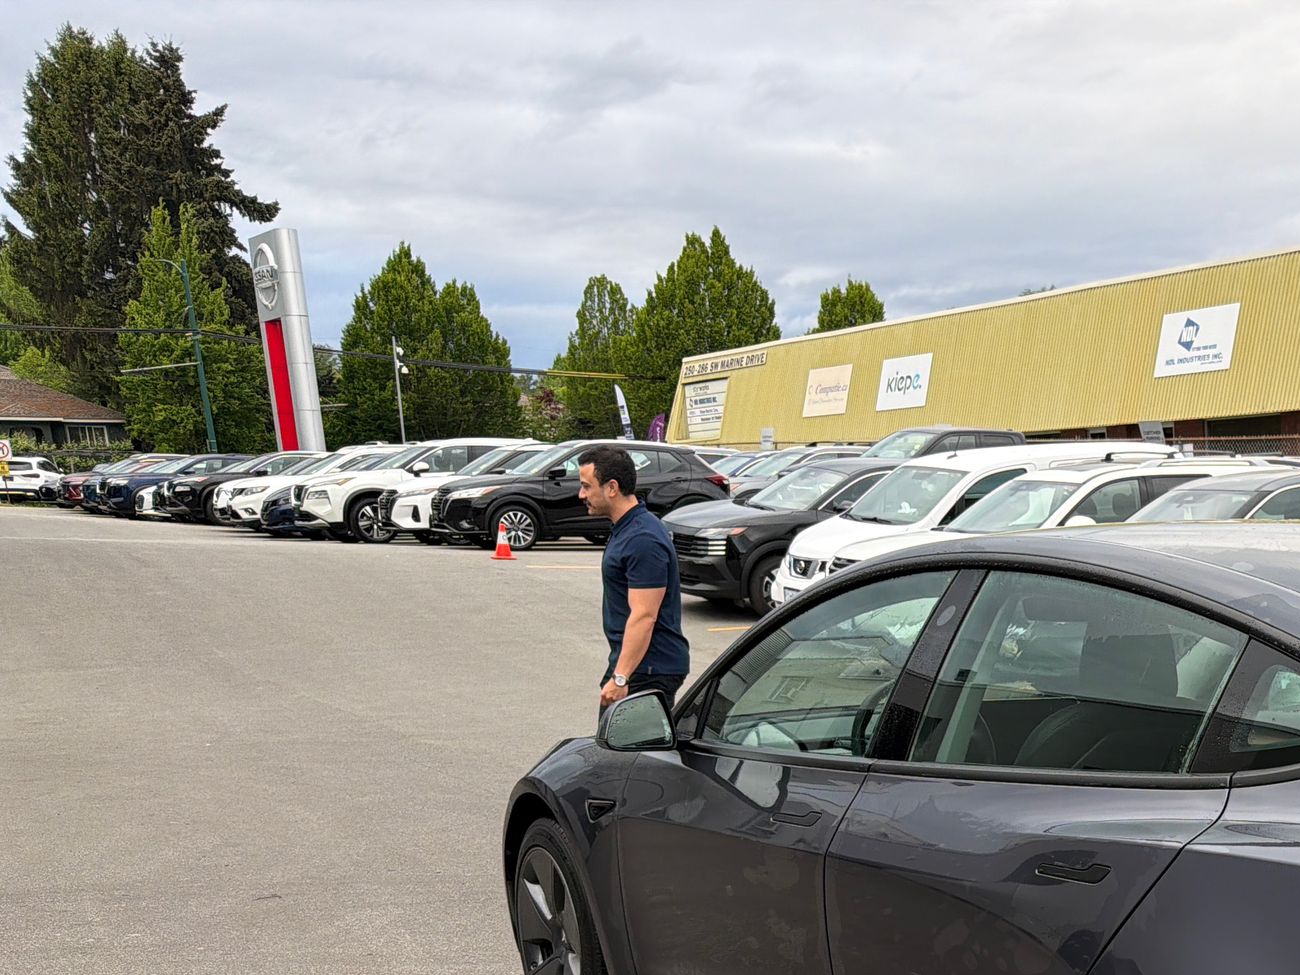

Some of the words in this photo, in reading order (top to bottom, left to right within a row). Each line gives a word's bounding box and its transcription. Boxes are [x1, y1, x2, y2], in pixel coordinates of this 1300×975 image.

[720, 356, 745, 369] MARINE
[745, 352, 766, 365] DRIVE
[1177, 353, 1211, 365] INDUSTRIES
